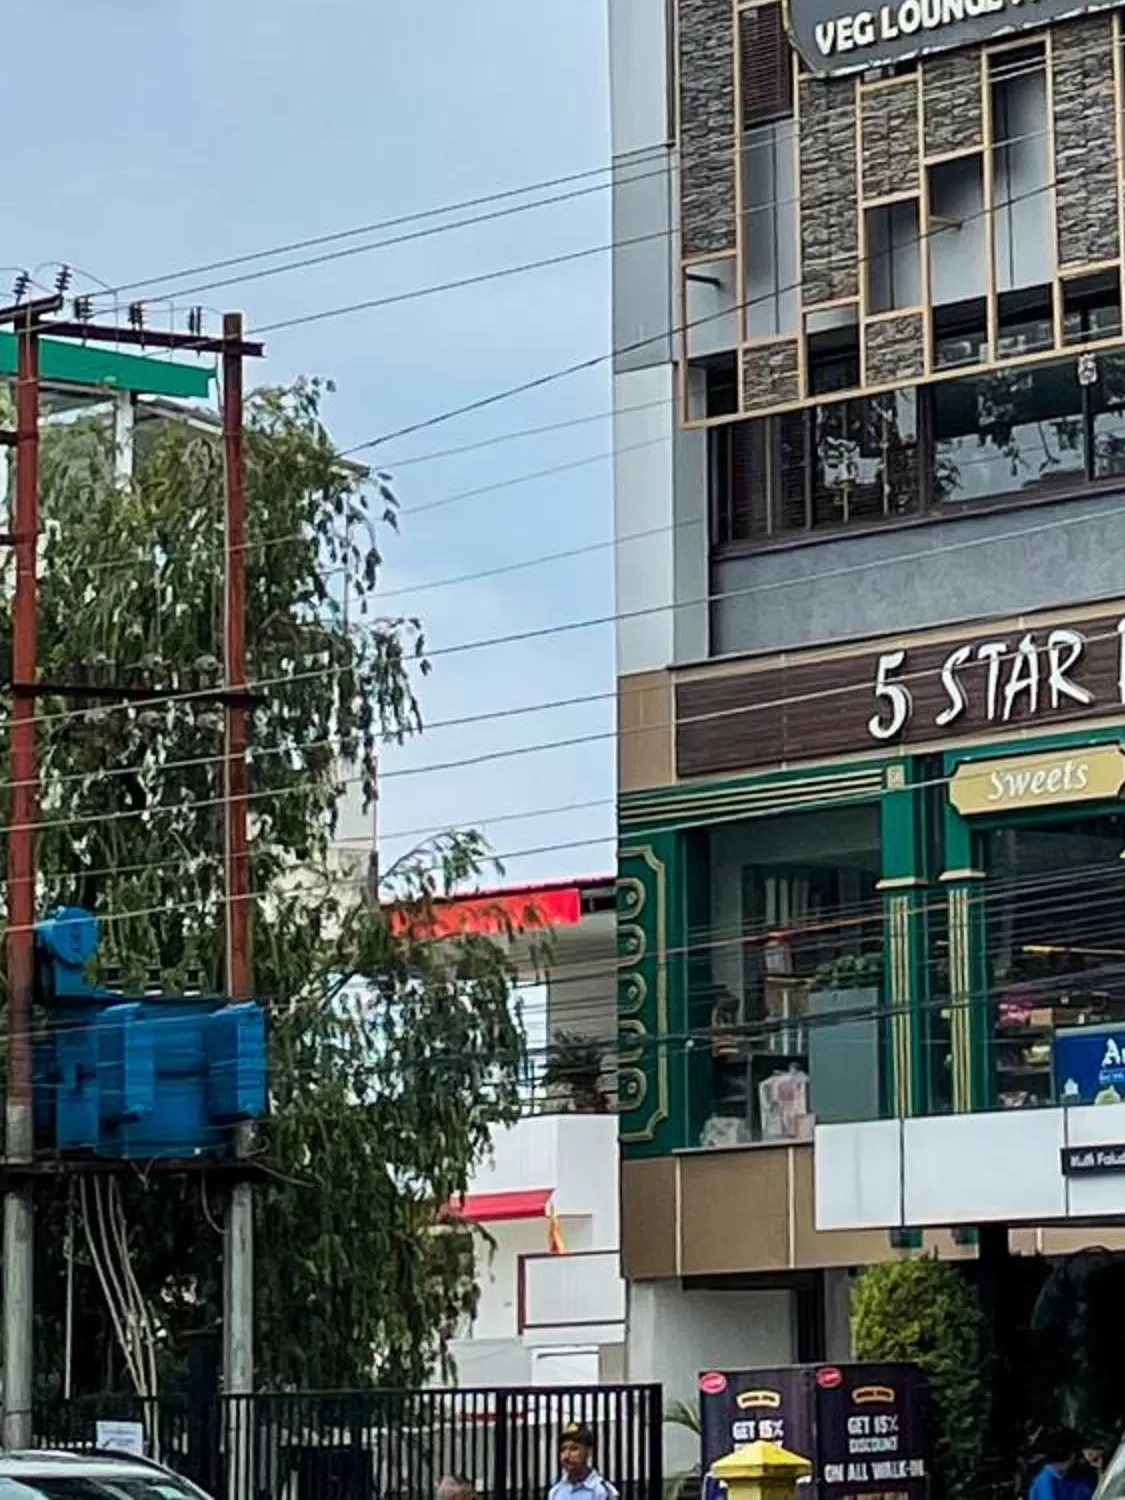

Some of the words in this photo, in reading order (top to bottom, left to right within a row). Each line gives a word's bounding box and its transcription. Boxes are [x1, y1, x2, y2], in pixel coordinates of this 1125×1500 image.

[815, 14, 875, 57] VEG
[868, 651, 912, 740] 5
[936, 629, 1092, 727] STAR
[988, 759, 1089, 801] Sweets
[733, 1421, 755, 1440] GET
[847, 1415, 870, 1435] GET
